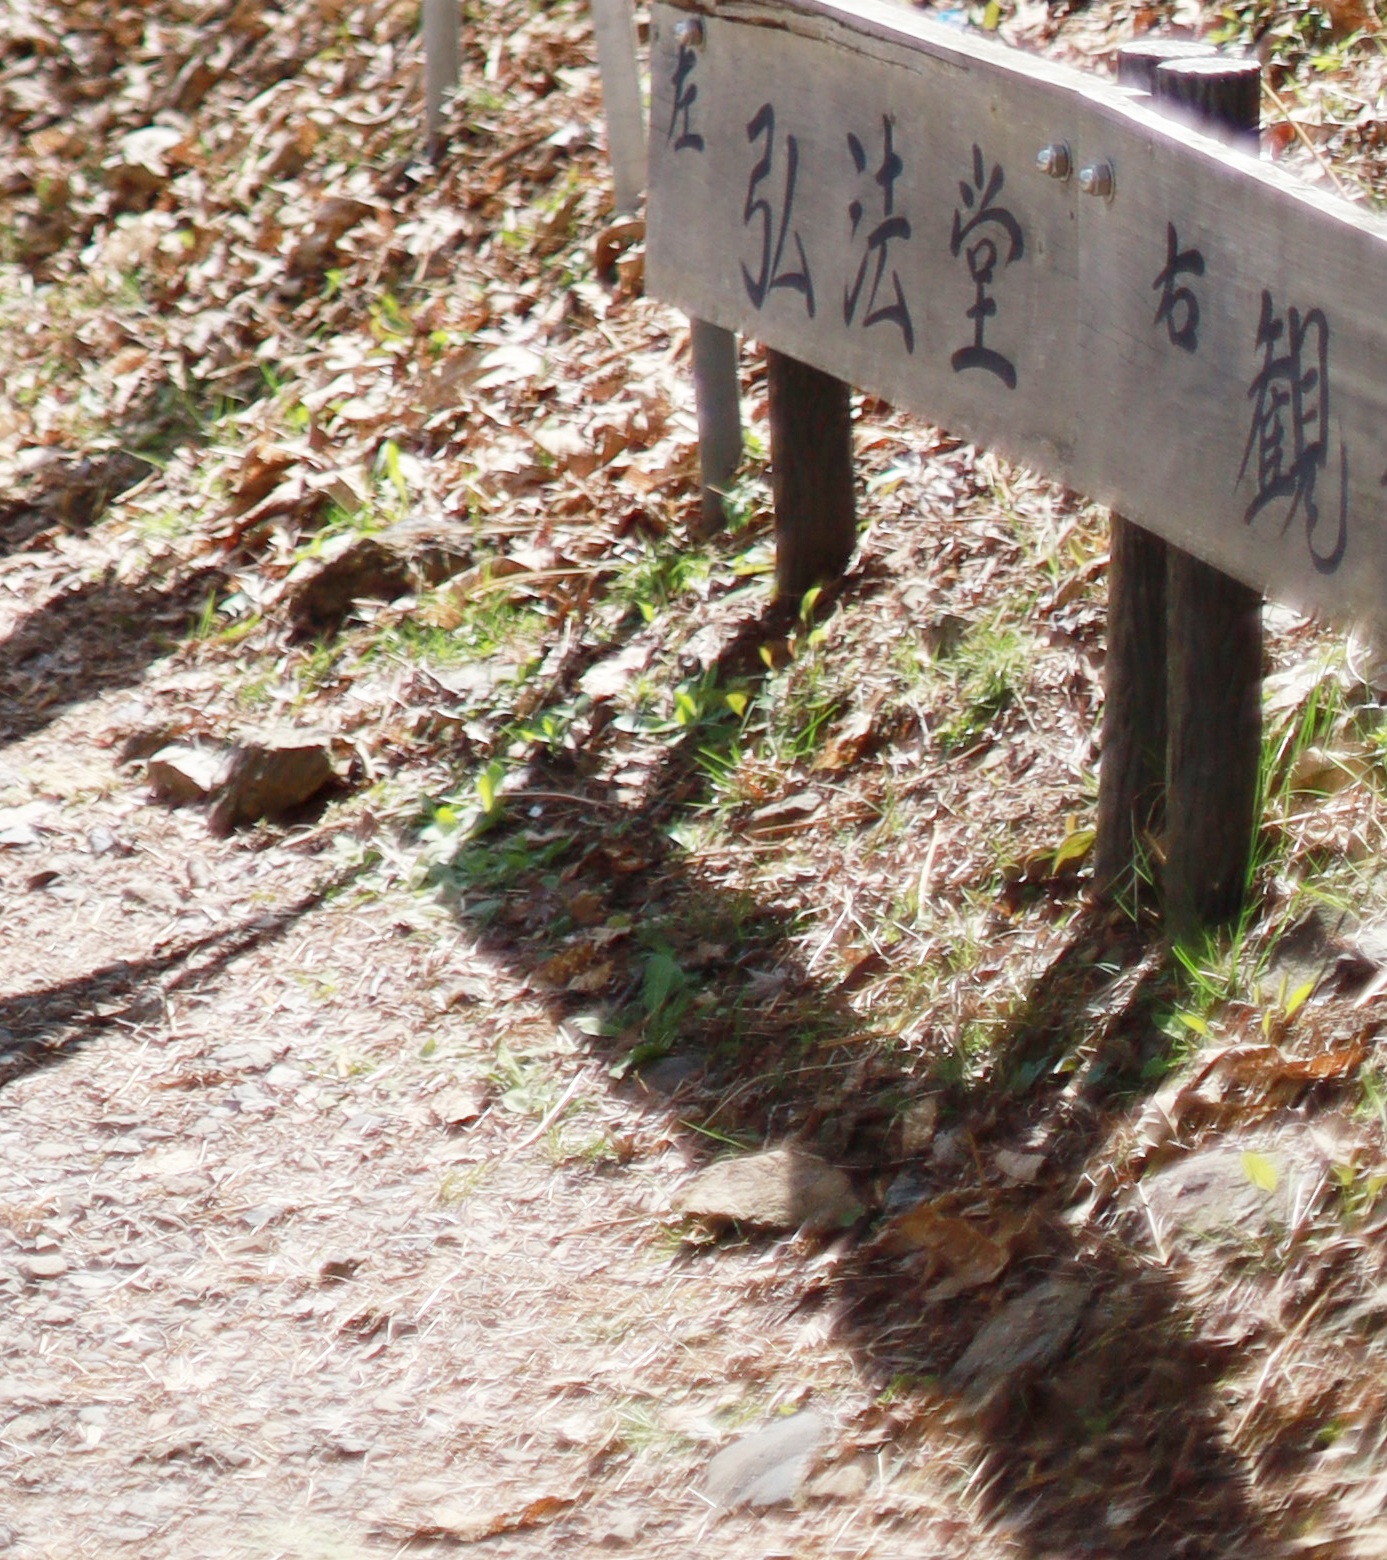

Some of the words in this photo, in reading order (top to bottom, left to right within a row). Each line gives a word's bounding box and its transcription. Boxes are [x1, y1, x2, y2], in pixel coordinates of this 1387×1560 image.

[667, 42, 705, 153] 左
[740, 102, 1025, 390] 弘法堂
[1152, 220, 1206, 354] 右
